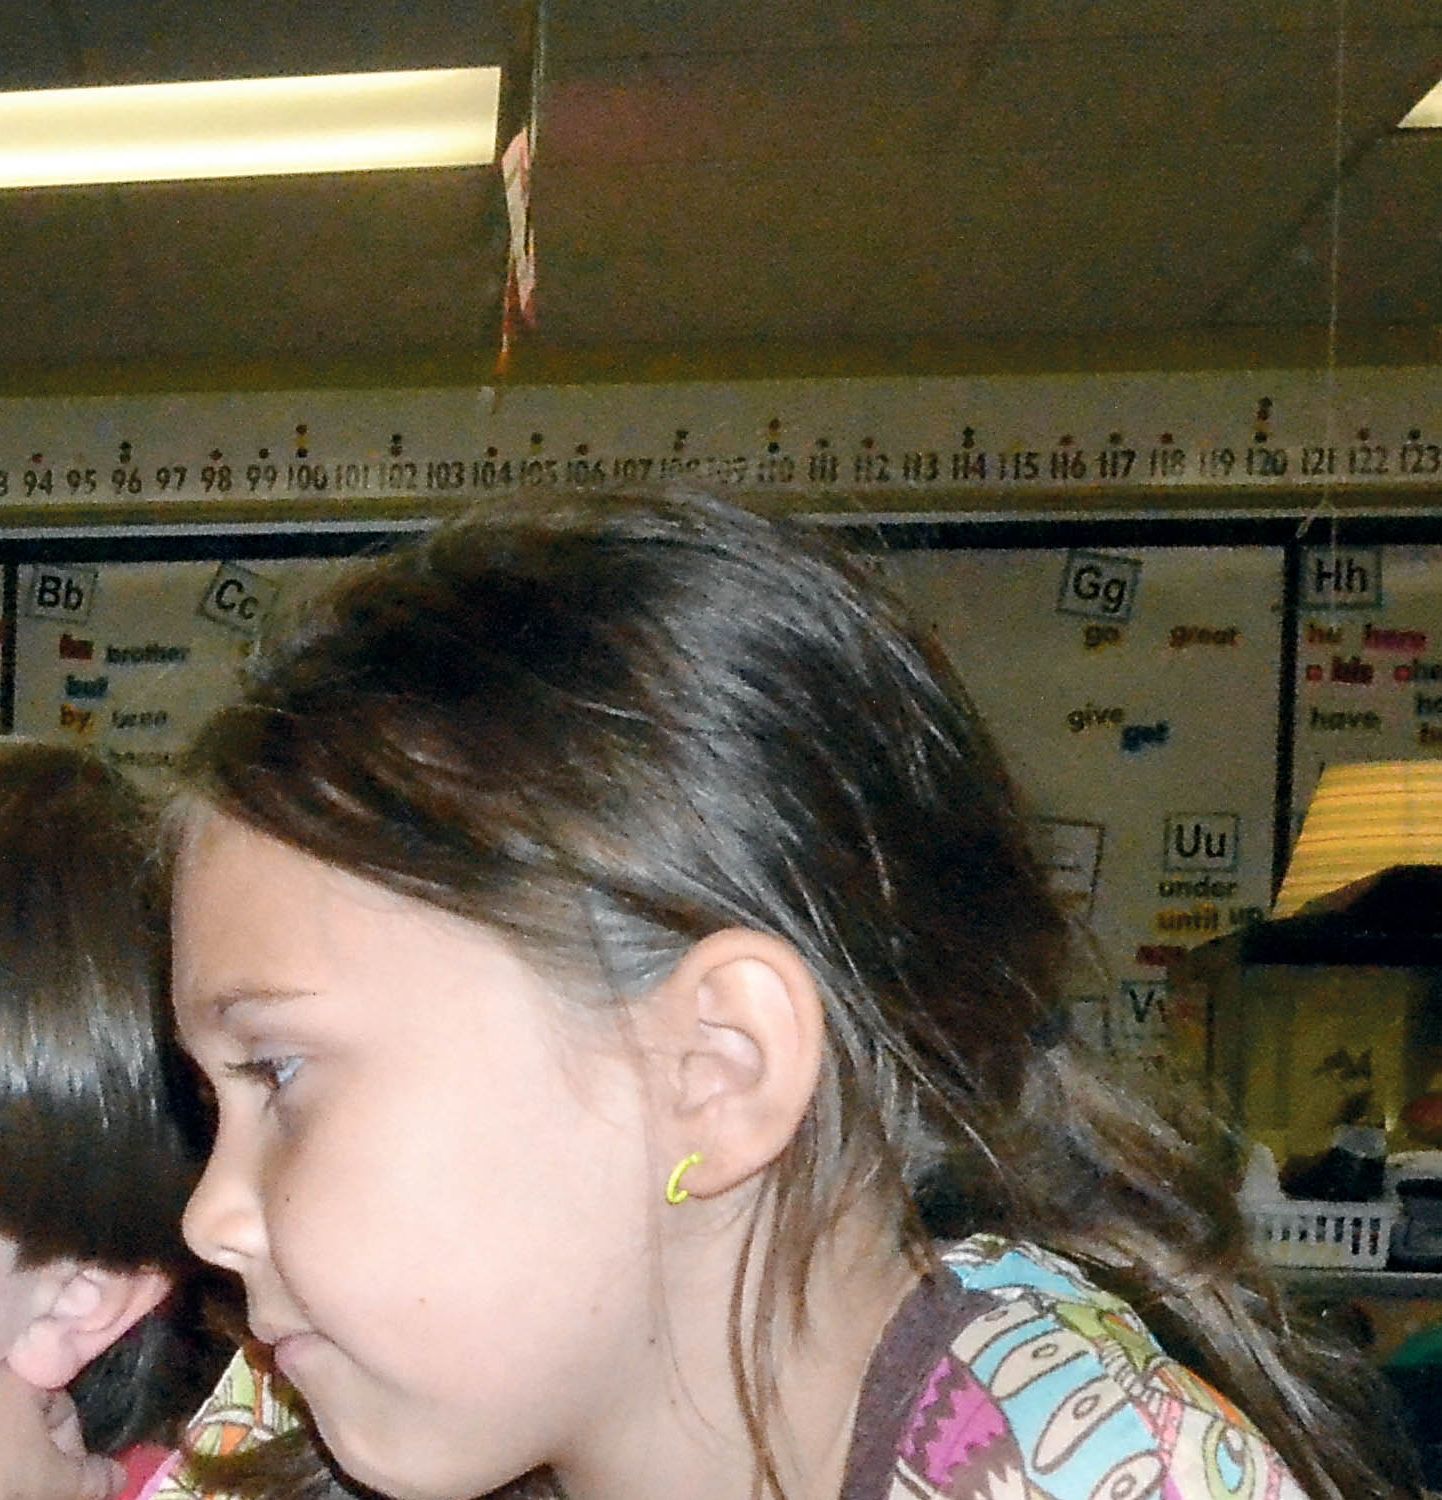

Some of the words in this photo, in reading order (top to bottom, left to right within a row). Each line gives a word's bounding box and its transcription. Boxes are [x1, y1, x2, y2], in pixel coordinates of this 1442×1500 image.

[23, 470, 53, 496] 94
[66, 468, 97, 495] 95
[111, 466, 142, 495] 96
[156, 465, 187, 493] 97
[200, 465, 233, 493] 98
[246, 464, 278, 492] 99
[287, 464, 328, 492] 100
[335, 463, 369, 489] 101
[379, 462, 418, 489] 102
[427, 460, 465, 489] 103
[472, 460, 513, 488] 104
[566, 458, 606, 484] 106
[615, 457, 653, 482] 107
[808, 454, 839, 483] 111
[854, 454, 891, 483] 112
[903, 453, 939, 481] 113
[952, 452, 986, 480] 114
[999, 451, 1040, 480] 115
[1050, 451, 1087, 480] 116
[1096, 448, 1136, 479] 117
[1150, 448, 1186, 477] 118
[1200, 448, 1236, 477] 119
[1246, 448, 1289, 476] 120
[1300, 447, 1335, 476] 121
[1348, 446, 1388, 475] 122
[1399, 444, 1441, 474] 123
[1072, 564, 1127, 613] Gg
[1317, 558, 1367, 592] Hh
[37, 574, 84, 611] Bb
[215, 578, 259, 620] Cc
[105, 640, 191, 664] brother
[1083, 624, 1121, 651] go
[1168, 625, 1240, 650] great
[60, 703, 92, 732] by
[1066, 702, 1126, 733] give
[1120, 720, 1170, 753] get
[1174, 823, 1226, 858] Uu
[1159, 877, 1238, 897] under
[1155, 906, 1219, 930] until
